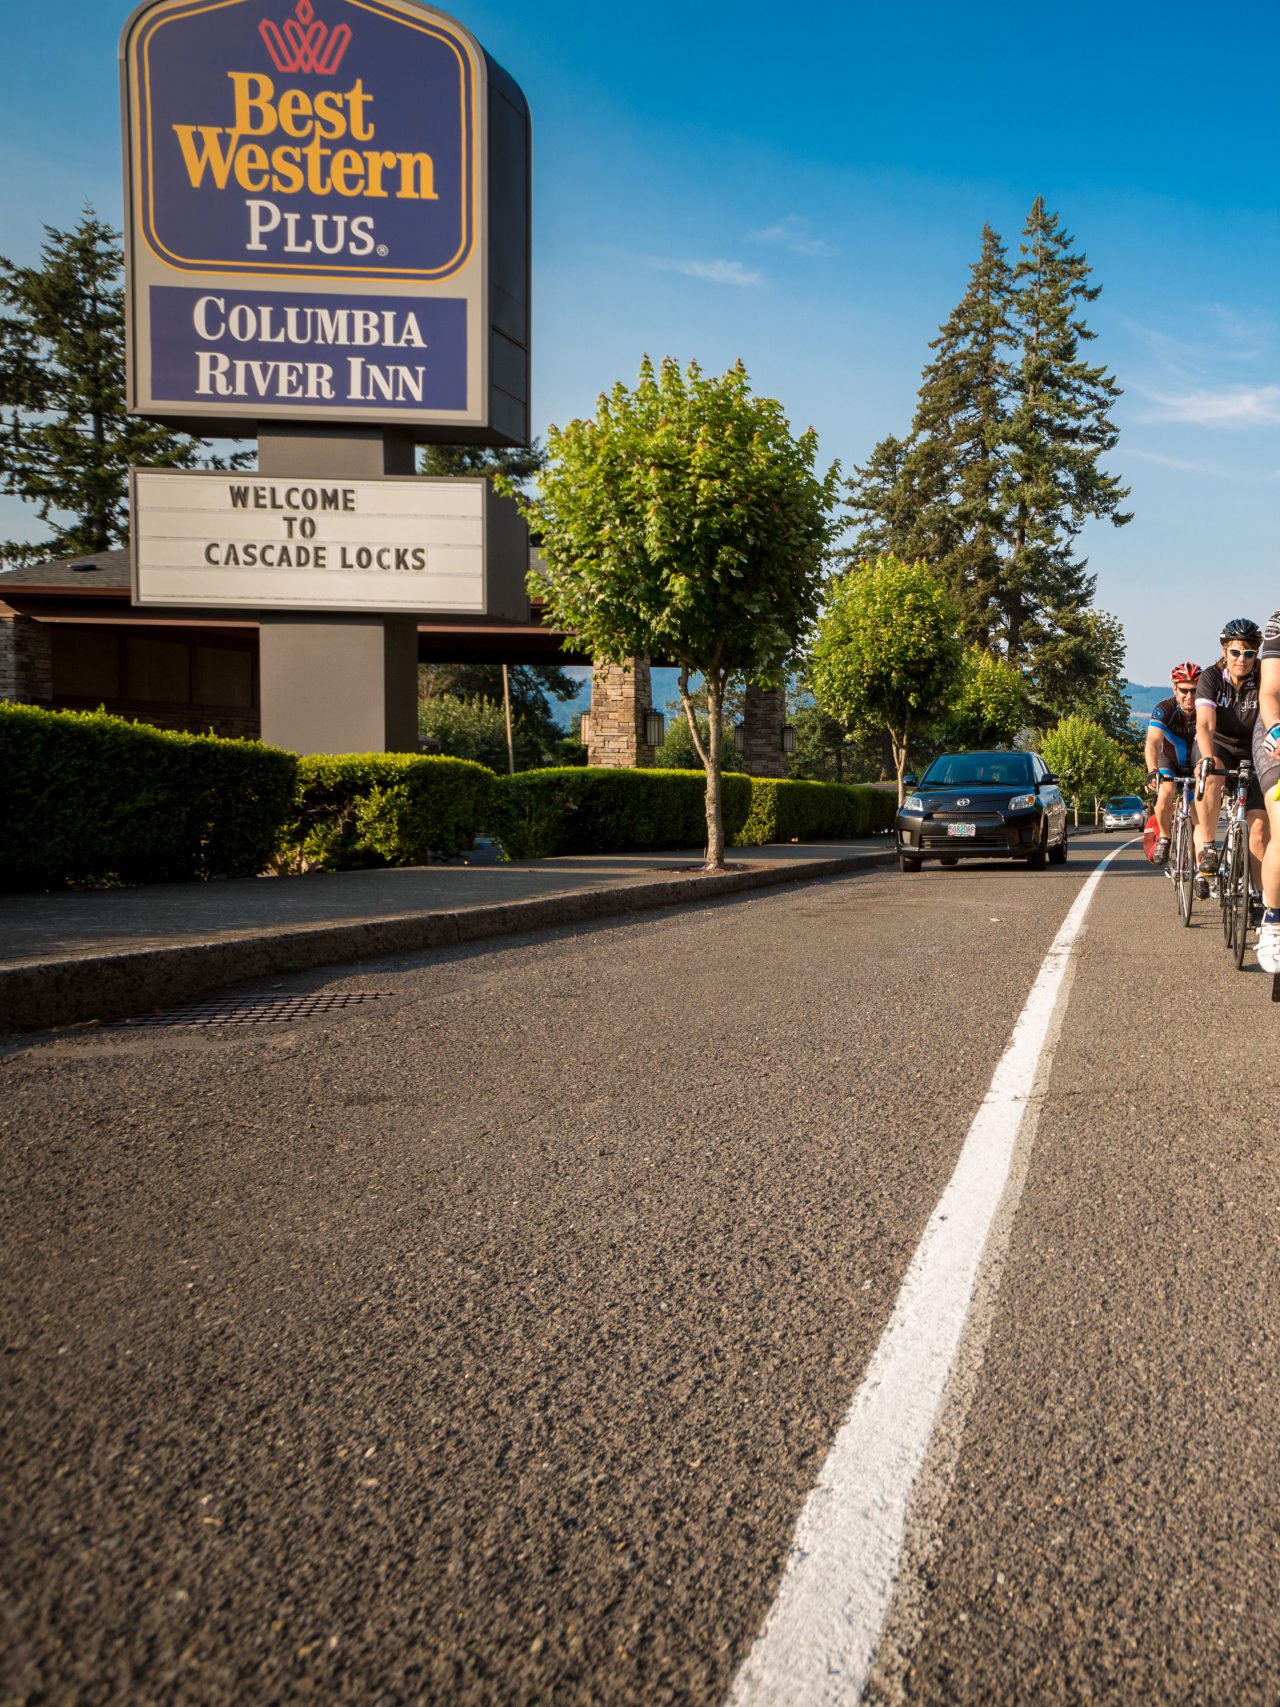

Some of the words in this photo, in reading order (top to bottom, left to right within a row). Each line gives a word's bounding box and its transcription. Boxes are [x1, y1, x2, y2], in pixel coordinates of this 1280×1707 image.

[227, 71, 375, 142] Best
[172, 124, 438, 200] Western
[192, 296, 428, 348] COLUMBIA
[194, 351, 336, 400] RIVER
[346, 357, 427, 402] INN
[229, 485, 356, 512] WELCOME
[282, 516, 317, 539] TO
[204, 542, 327, 569] CASCADE
[340, 546, 427, 571] LOCKS
